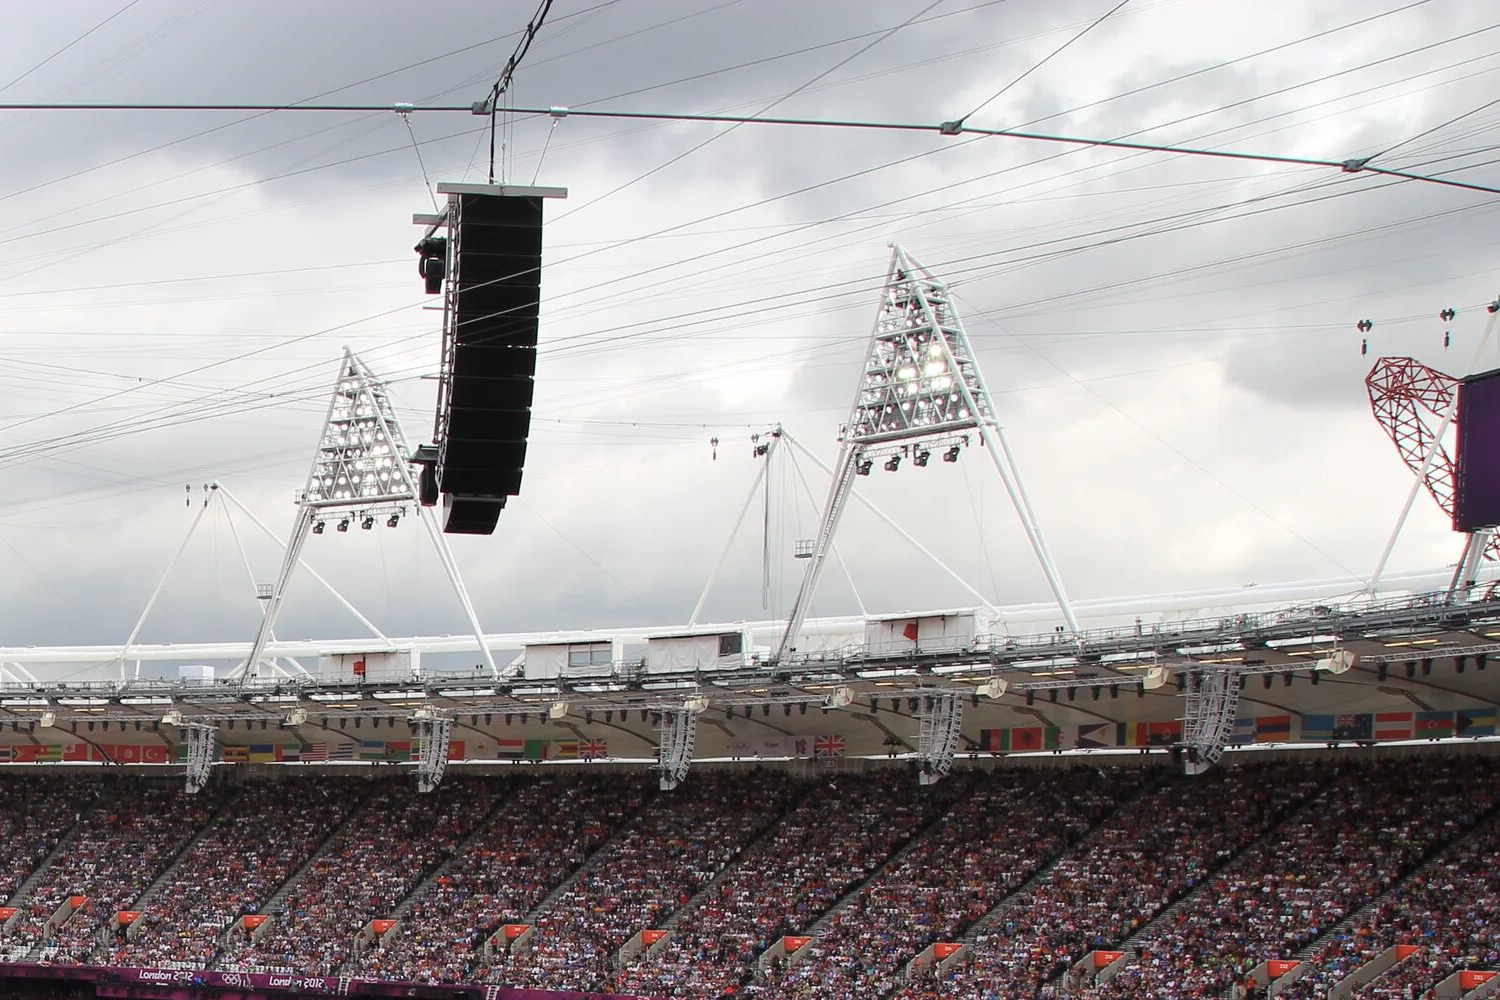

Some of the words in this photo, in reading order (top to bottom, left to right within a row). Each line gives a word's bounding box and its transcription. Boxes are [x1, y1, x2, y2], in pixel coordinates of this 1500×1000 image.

[139, 970, 171, 980] London
[269, 976, 302, 987] Londn
[304, 978, 324, 989] 2012
